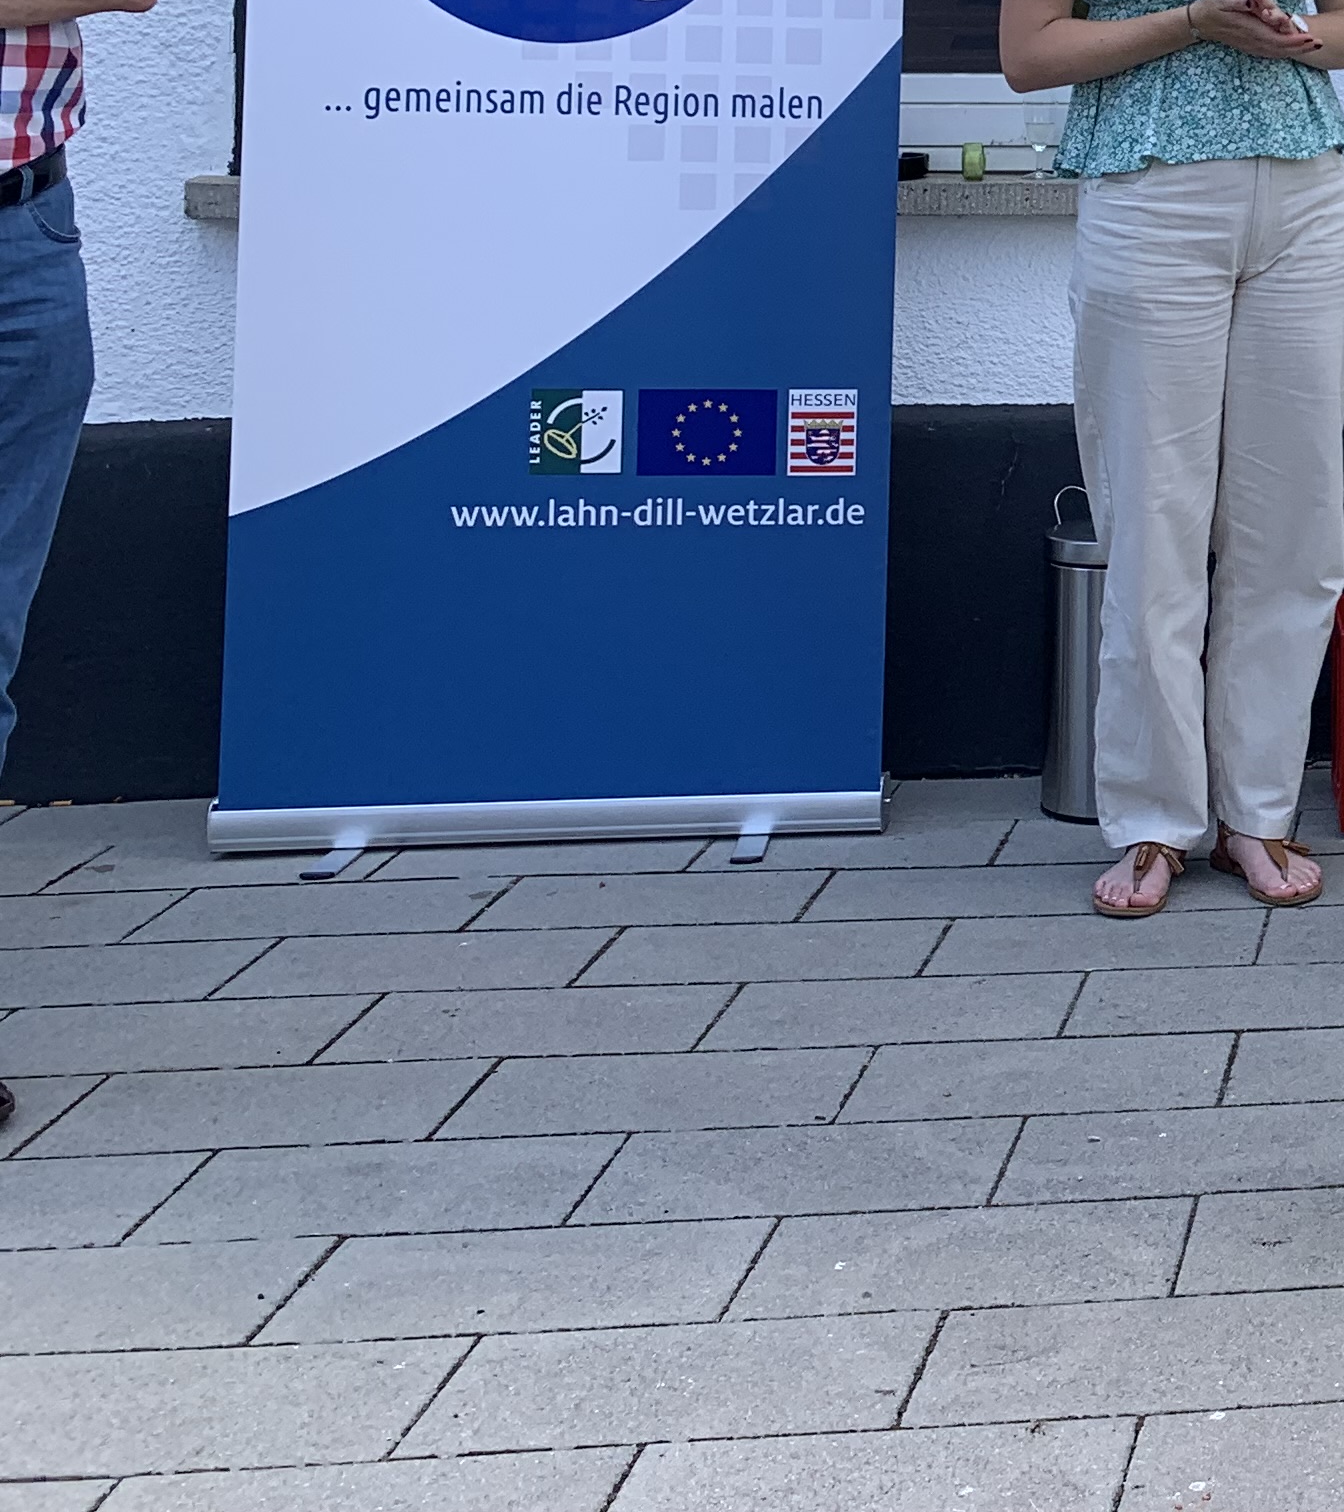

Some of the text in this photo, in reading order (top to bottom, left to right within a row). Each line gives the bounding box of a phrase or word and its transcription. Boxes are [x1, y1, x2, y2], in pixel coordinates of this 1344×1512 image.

[364, 86, 545, 119] gemeinsam
[556, 84, 602, 116] die
[614, 85, 719, 124] Region
[732, 86, 824, 120] malen
[791, 393, 857, 408] HESSEN
[529, 399, 543, 466] LEADER
[451, 498, 866, 528] www.lahn-dill-wetzlar.de
